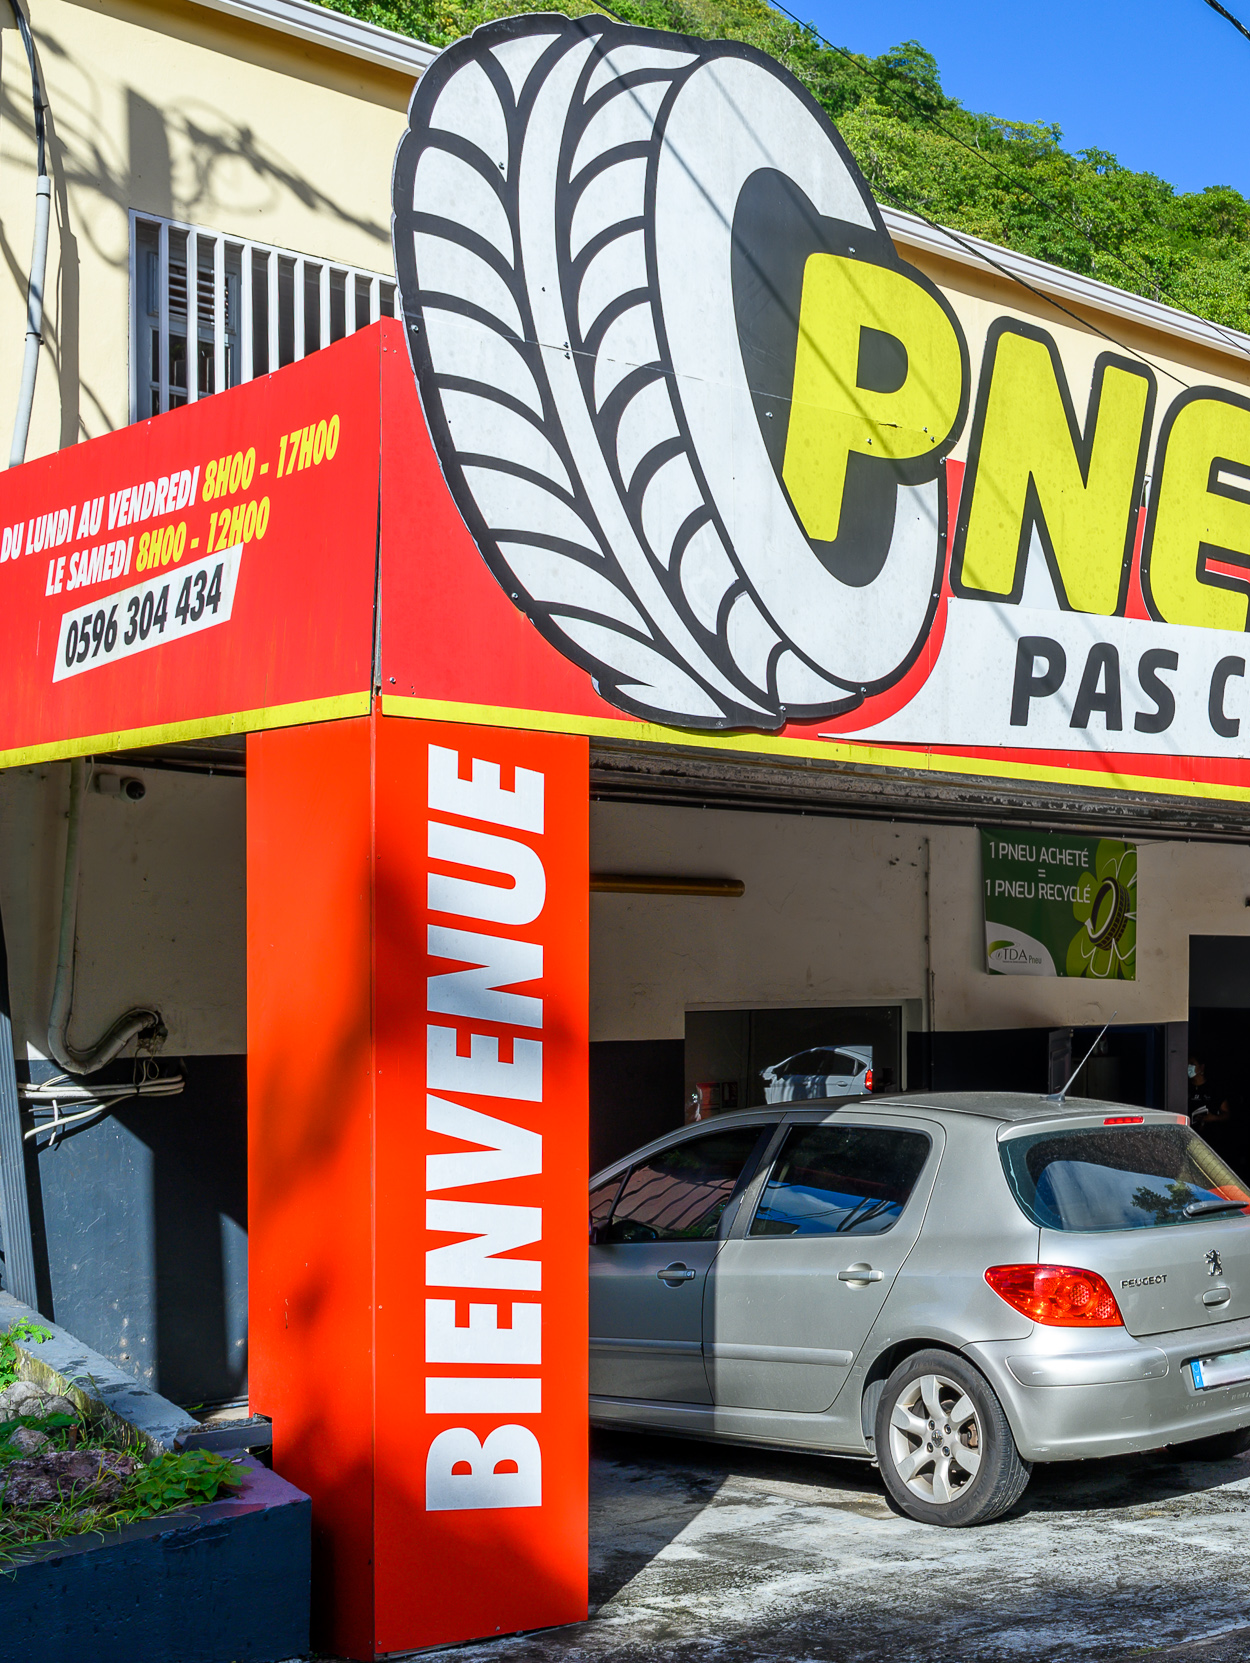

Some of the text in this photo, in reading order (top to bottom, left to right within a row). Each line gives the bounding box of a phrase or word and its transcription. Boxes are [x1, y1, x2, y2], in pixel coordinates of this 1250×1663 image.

[0, 414, 340, 563] DU LUNDI AU VENDREDI 8H00 - 17H00
[45, 497, 270, 597] LE SAMEDI 8H00 - 12H00
[65, 563, 224, 668] 0596 304 434
[1010, 635, 1180, 735] PAS
[989, 841, 1089, 867] 1 PNEU ACHETÉ
[1038, 869, 1046, 878] =
[985, 879, 1091, 903] 1 PNEU RECYCLÉ
[1003, 948, 1028, 961] TDA
[425, 743, 546, 1512] BIENVENUE
[1120, 1274, 1168, 1290] PEUGEOT
